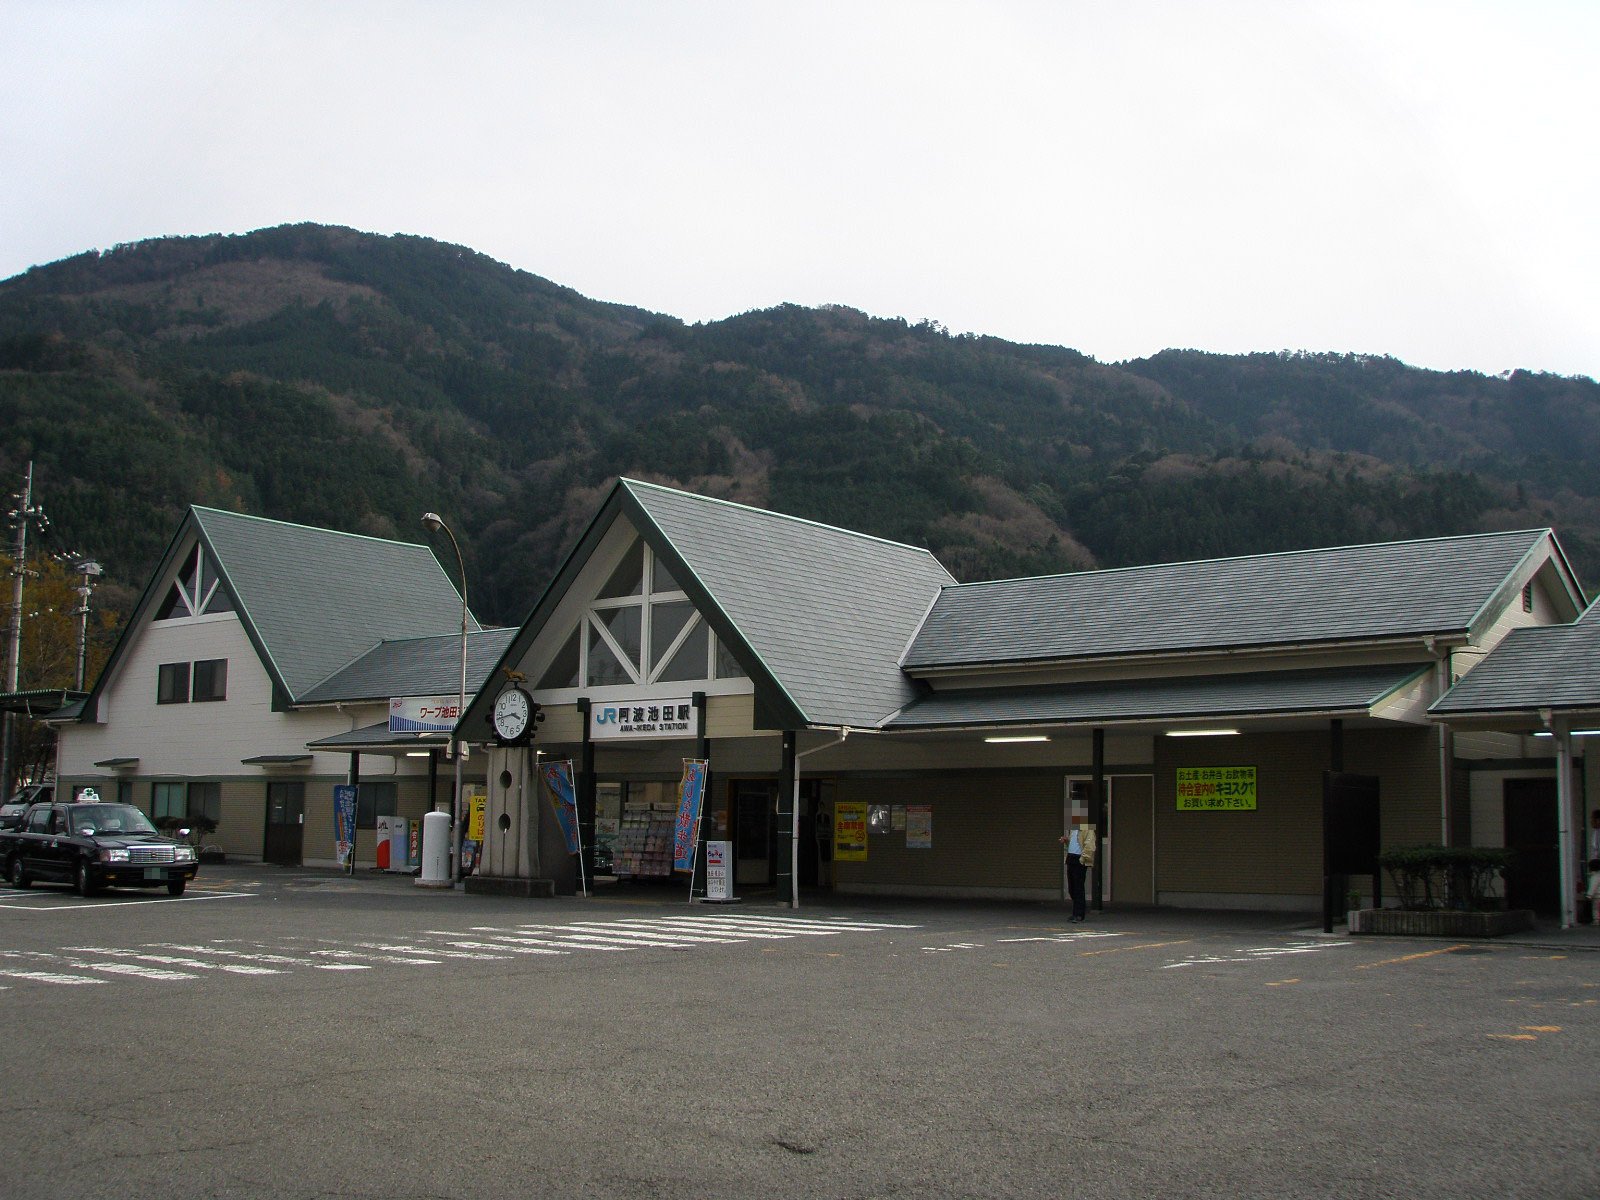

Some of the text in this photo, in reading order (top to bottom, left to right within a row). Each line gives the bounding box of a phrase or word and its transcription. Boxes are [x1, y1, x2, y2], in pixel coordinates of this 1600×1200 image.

[596, 704, 690, 725] JR 阿波池田駅
[500, 718, 504, 727] 8
[620, 722, 688, 732] AWA-IKEDA STATION
[510, 727, 514, 735] 6
